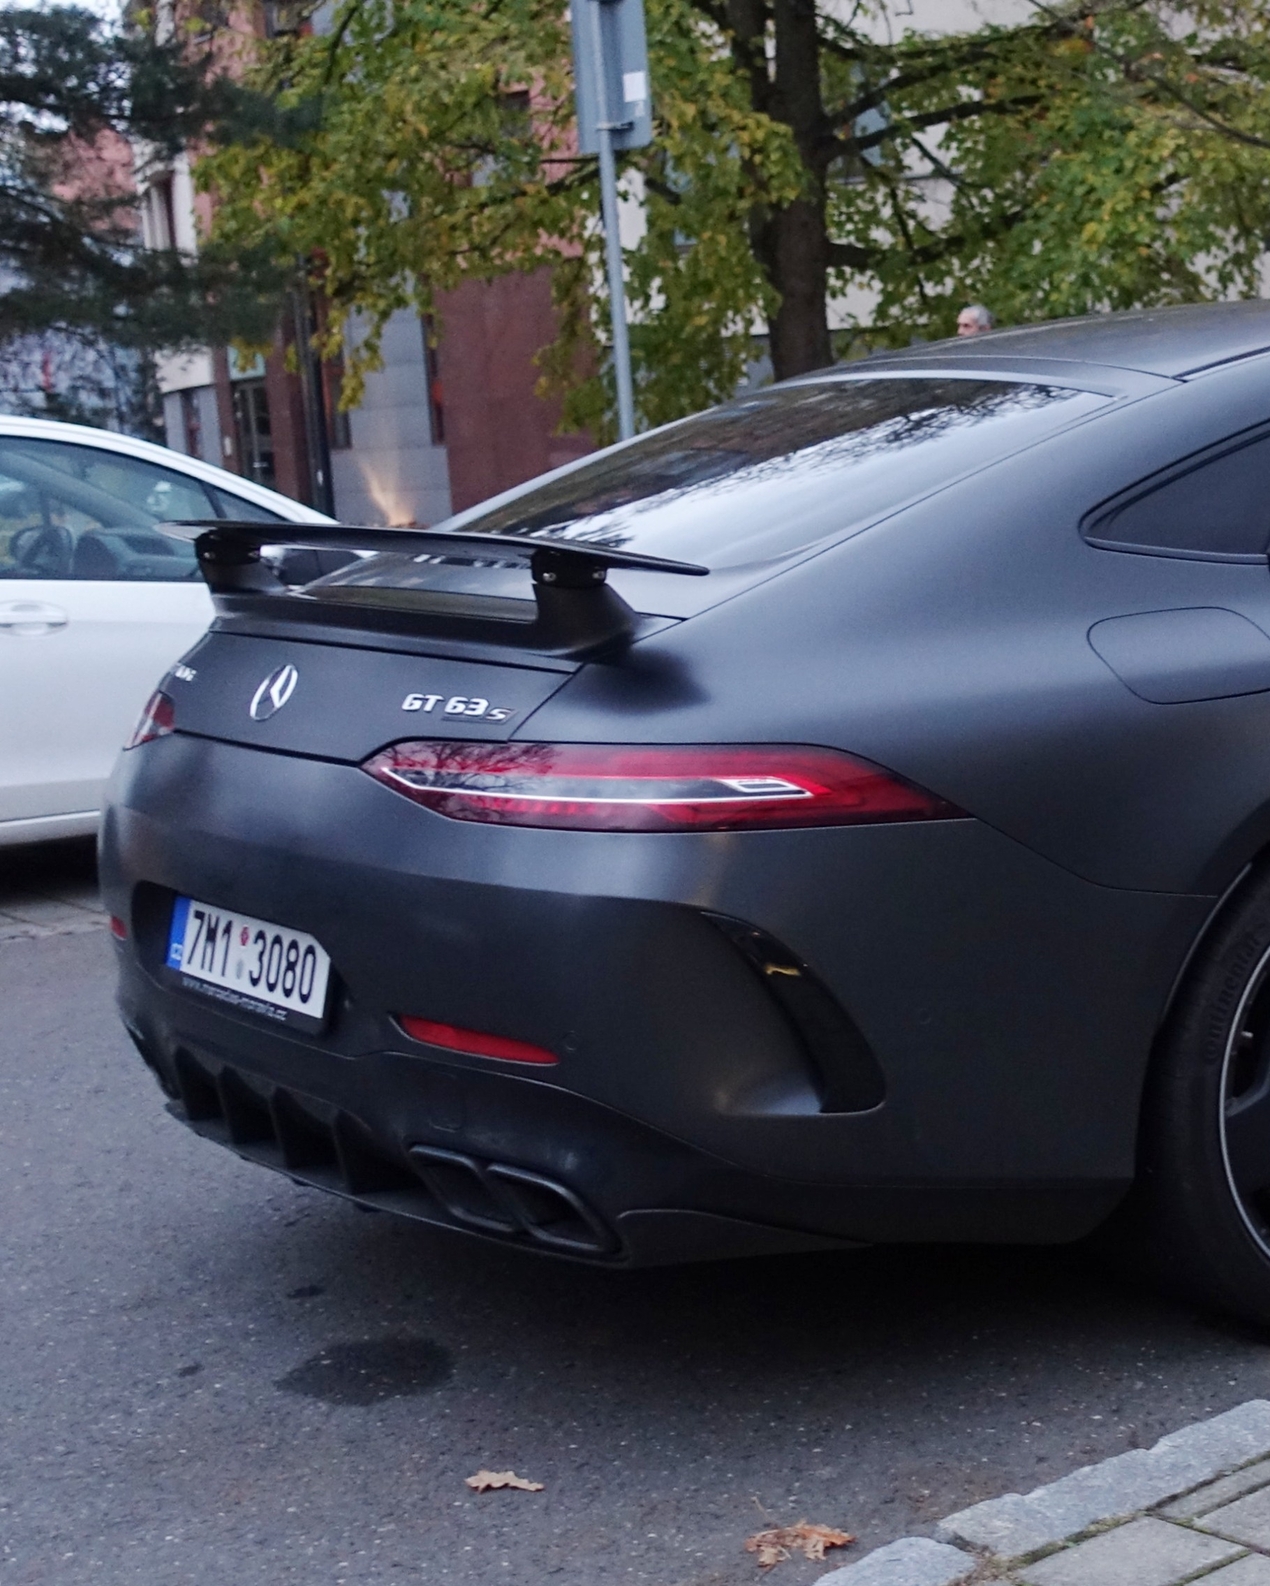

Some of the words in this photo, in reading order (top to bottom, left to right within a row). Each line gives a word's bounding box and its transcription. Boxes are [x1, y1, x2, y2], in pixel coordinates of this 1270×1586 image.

[401, 693, 444, 712] GT
[444, 696, 489, 716] 63
[187, 910, 233, 977] 7M1
[249, 930, 317, 1004] 3080
